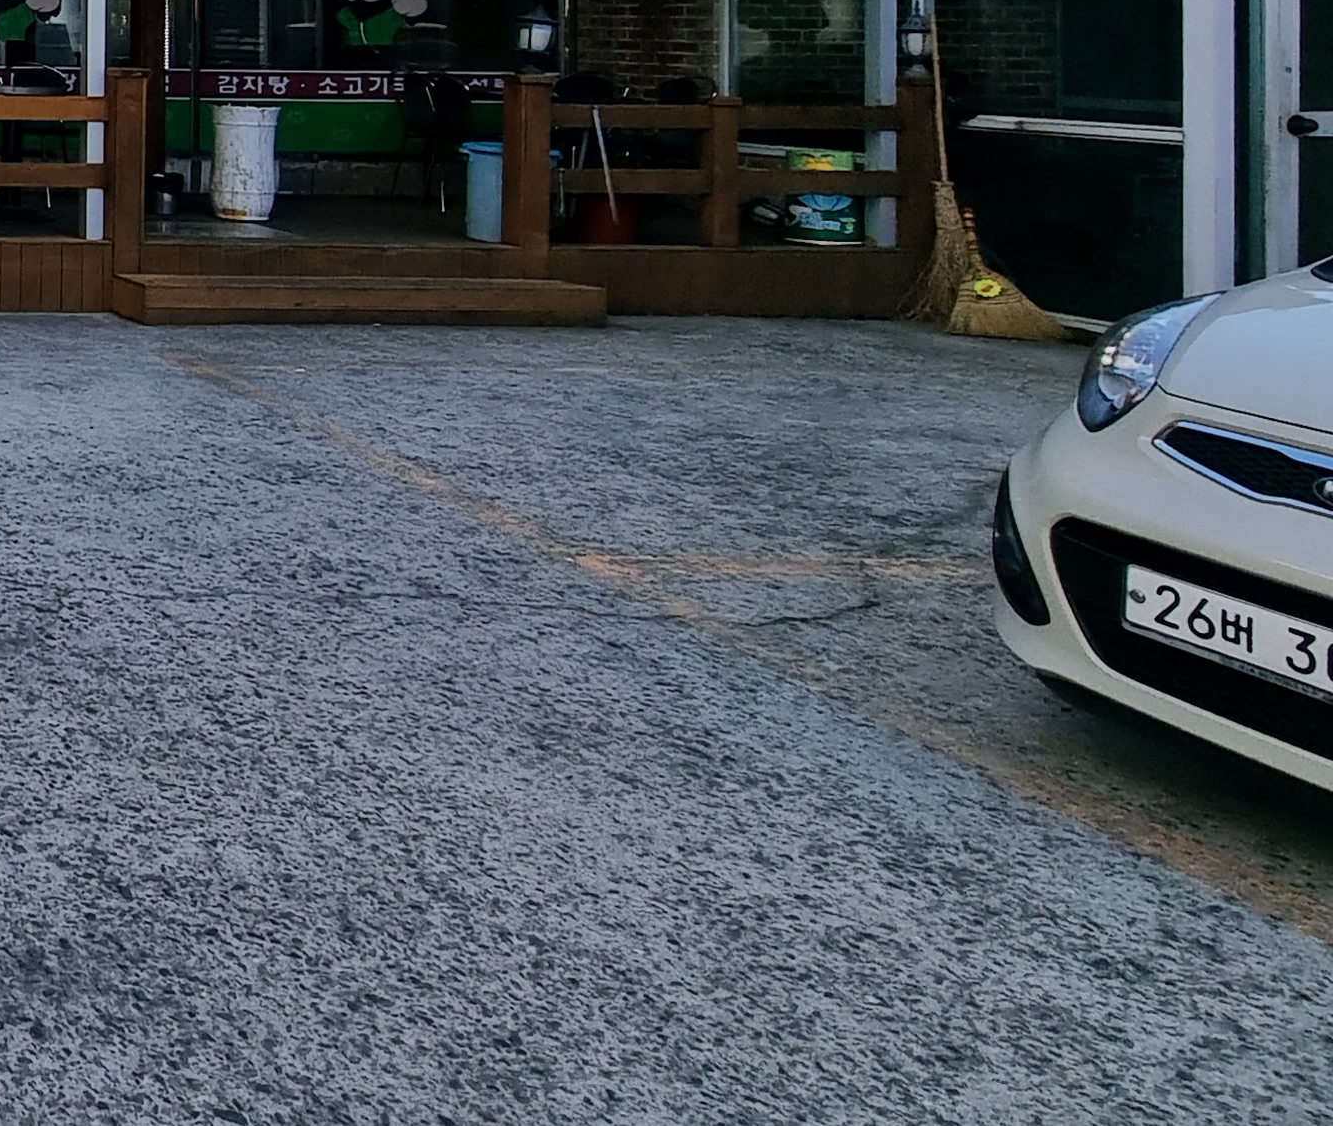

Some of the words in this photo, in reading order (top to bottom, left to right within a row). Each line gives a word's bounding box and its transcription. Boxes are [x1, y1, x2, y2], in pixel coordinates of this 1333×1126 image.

[217, 75, 290, 95] 감자탕
[1154, 585, 1253, 654] 26버
[1286, 627, 1333, 682] 3
